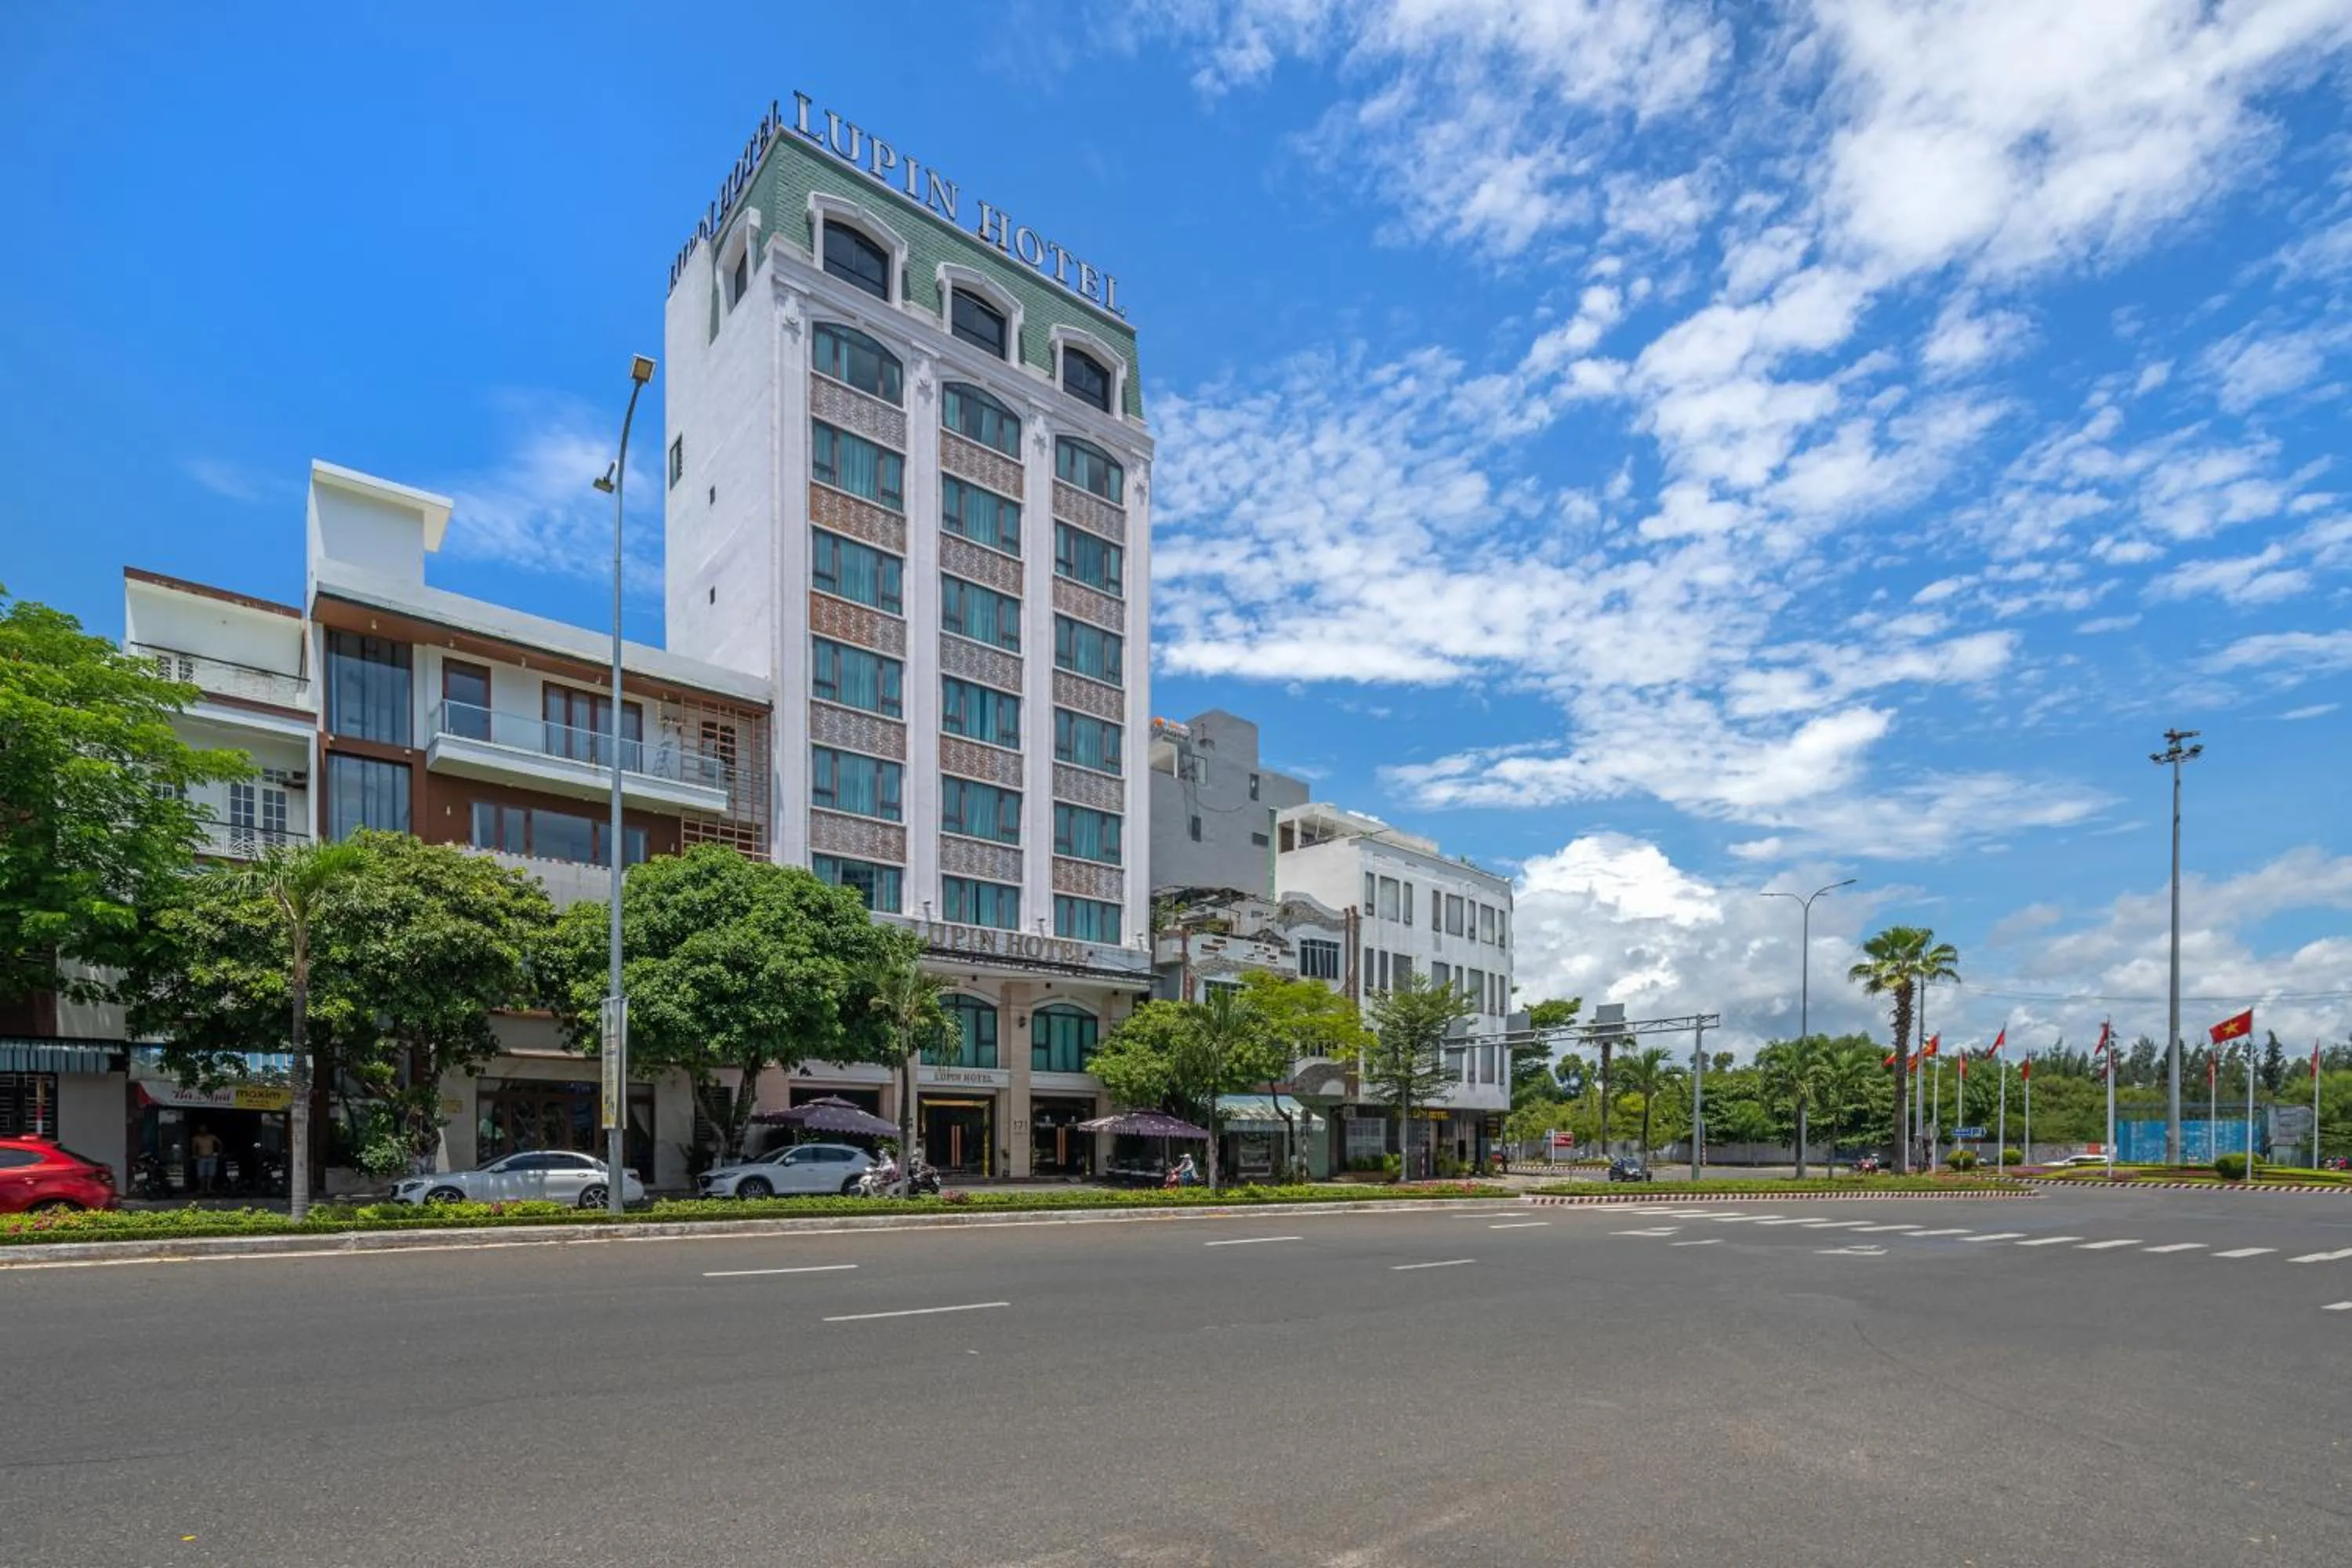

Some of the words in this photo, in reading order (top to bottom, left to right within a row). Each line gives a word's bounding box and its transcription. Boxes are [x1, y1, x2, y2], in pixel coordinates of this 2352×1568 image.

[717, 100, 782, 221] HOTEL
[793, 89, 959, 220] LUPIN
[977, 199, 1127, 317] HOTEL
[1006, 933, 1089, 964] HOTEL
[236, 1089, 281, 1100] maxim
